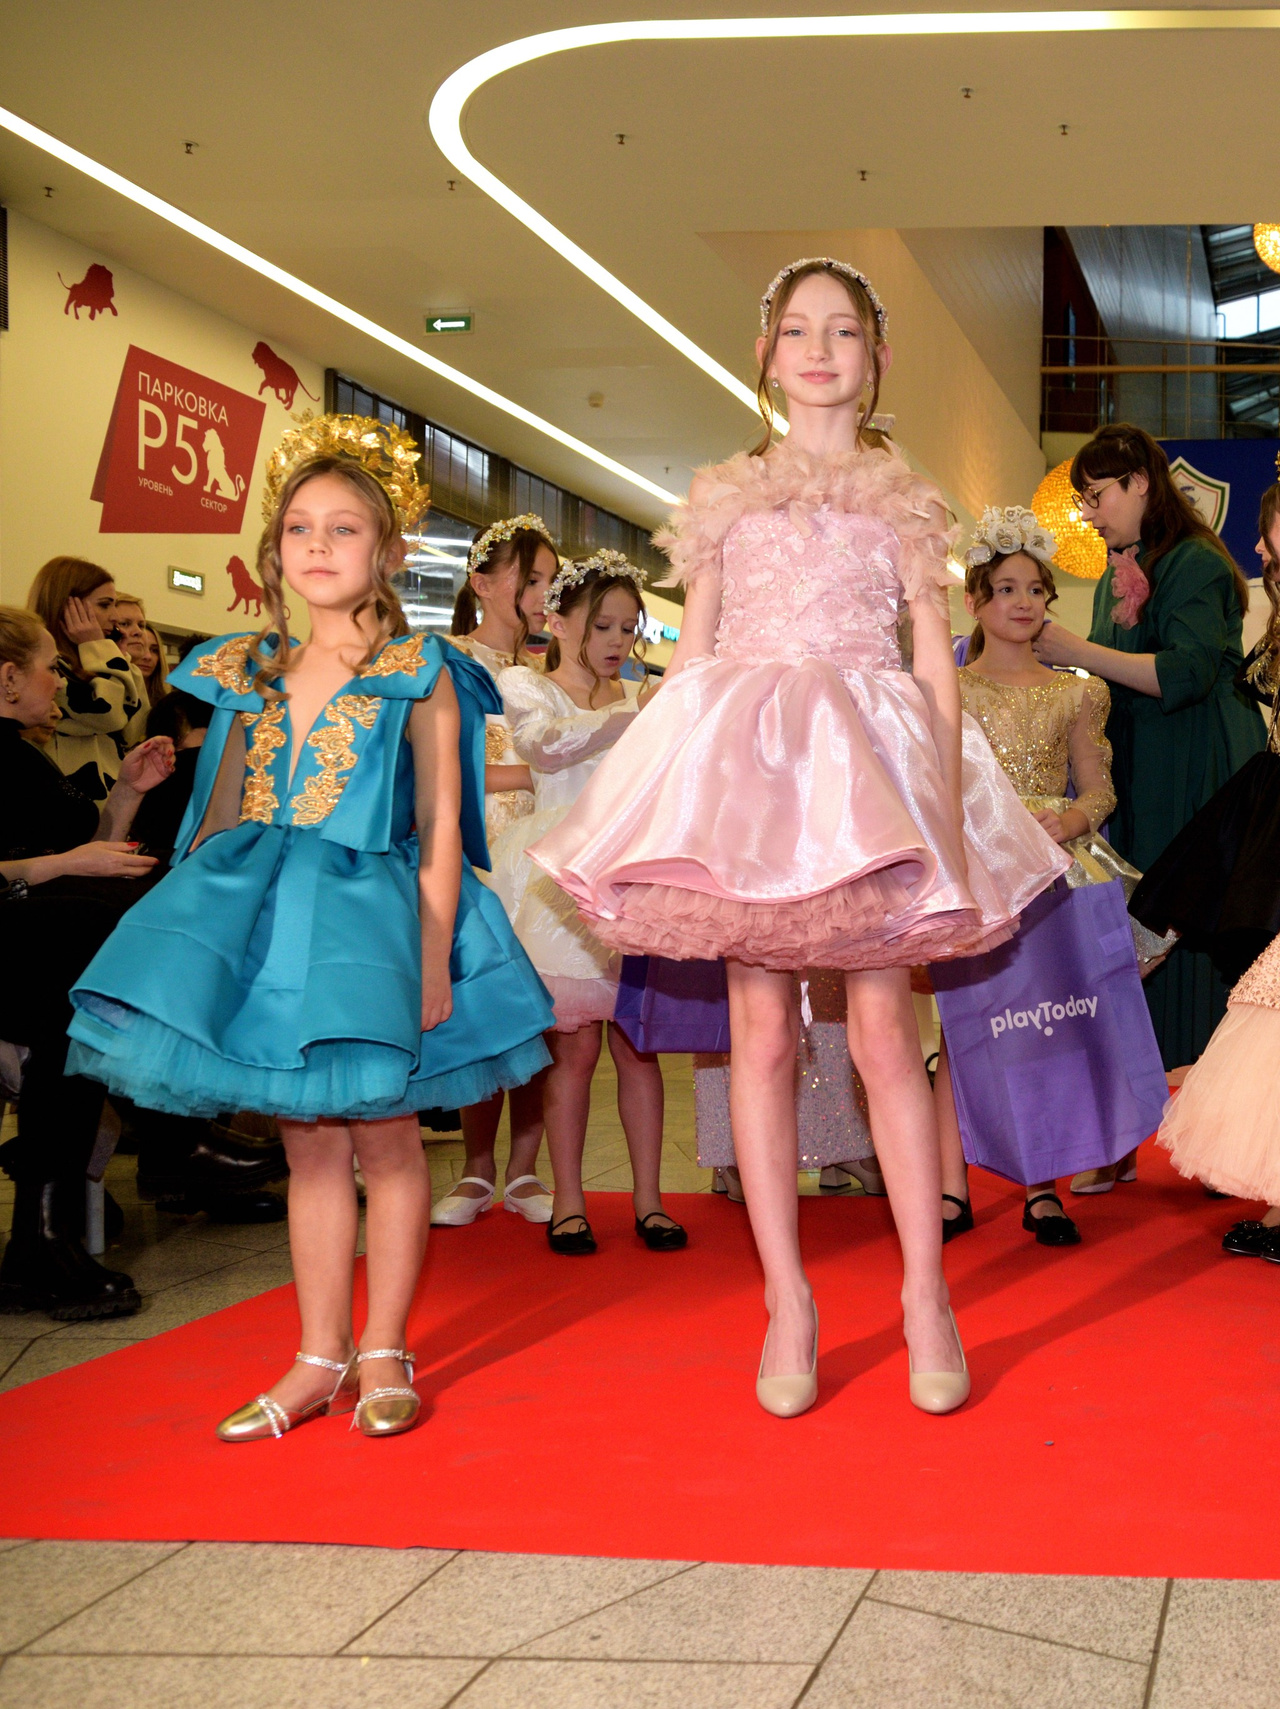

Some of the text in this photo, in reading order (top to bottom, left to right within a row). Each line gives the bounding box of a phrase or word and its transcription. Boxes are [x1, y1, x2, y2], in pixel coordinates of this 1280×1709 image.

[138, 371, 229, 427] ПАРКОВКА
[138, 399, 198, 485] P5
[138, 476, 174, 497] УРОВЕНЬ
[200, 497, 228, 514] СЕКТОР
[990, 995, 1099, 1039] playToday
